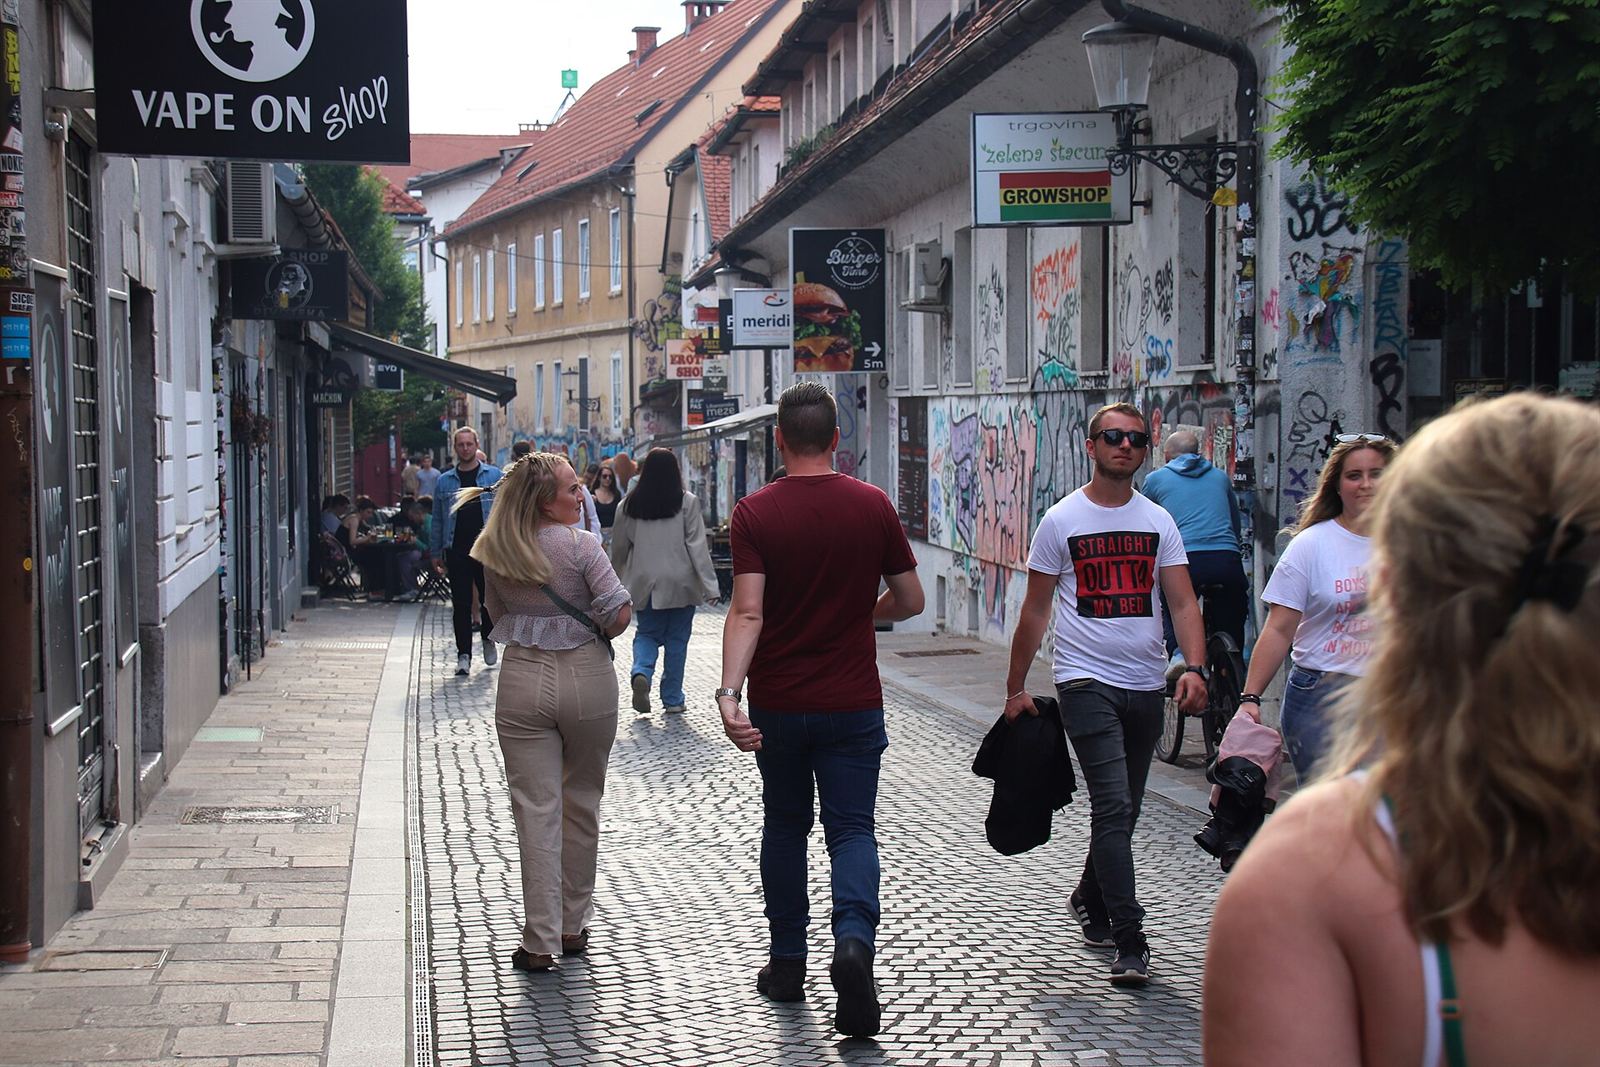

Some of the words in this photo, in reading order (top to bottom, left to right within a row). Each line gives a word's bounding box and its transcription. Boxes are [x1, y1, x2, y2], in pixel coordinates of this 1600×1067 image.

[131, 89, 235, 131] VAPE
[251, 94, 311, 133] ON
[322, 75, 389, 141] shop
[1008, 118, 1097, 133] trgovina
[1003, 187, 1108, 205] GROWSHOP
[288, 252, 329, 262] SHOP
[826, 248, 882, 268] Burger
[842, 265, 869, 277] Time
[864, 359, 884, 369] 5m
[706, 406, 736, 417] meze
[1077, 535, 1152, 557] STRAIGHT
[1083, 560, 1149, 593] OUTTA
[1335, 577, 1368, 594] BOYS
[1093, 599, 1113, 617] MY
[1120, 597, 1144, 615] BED
[1323, 640, 1339, 653] IN
